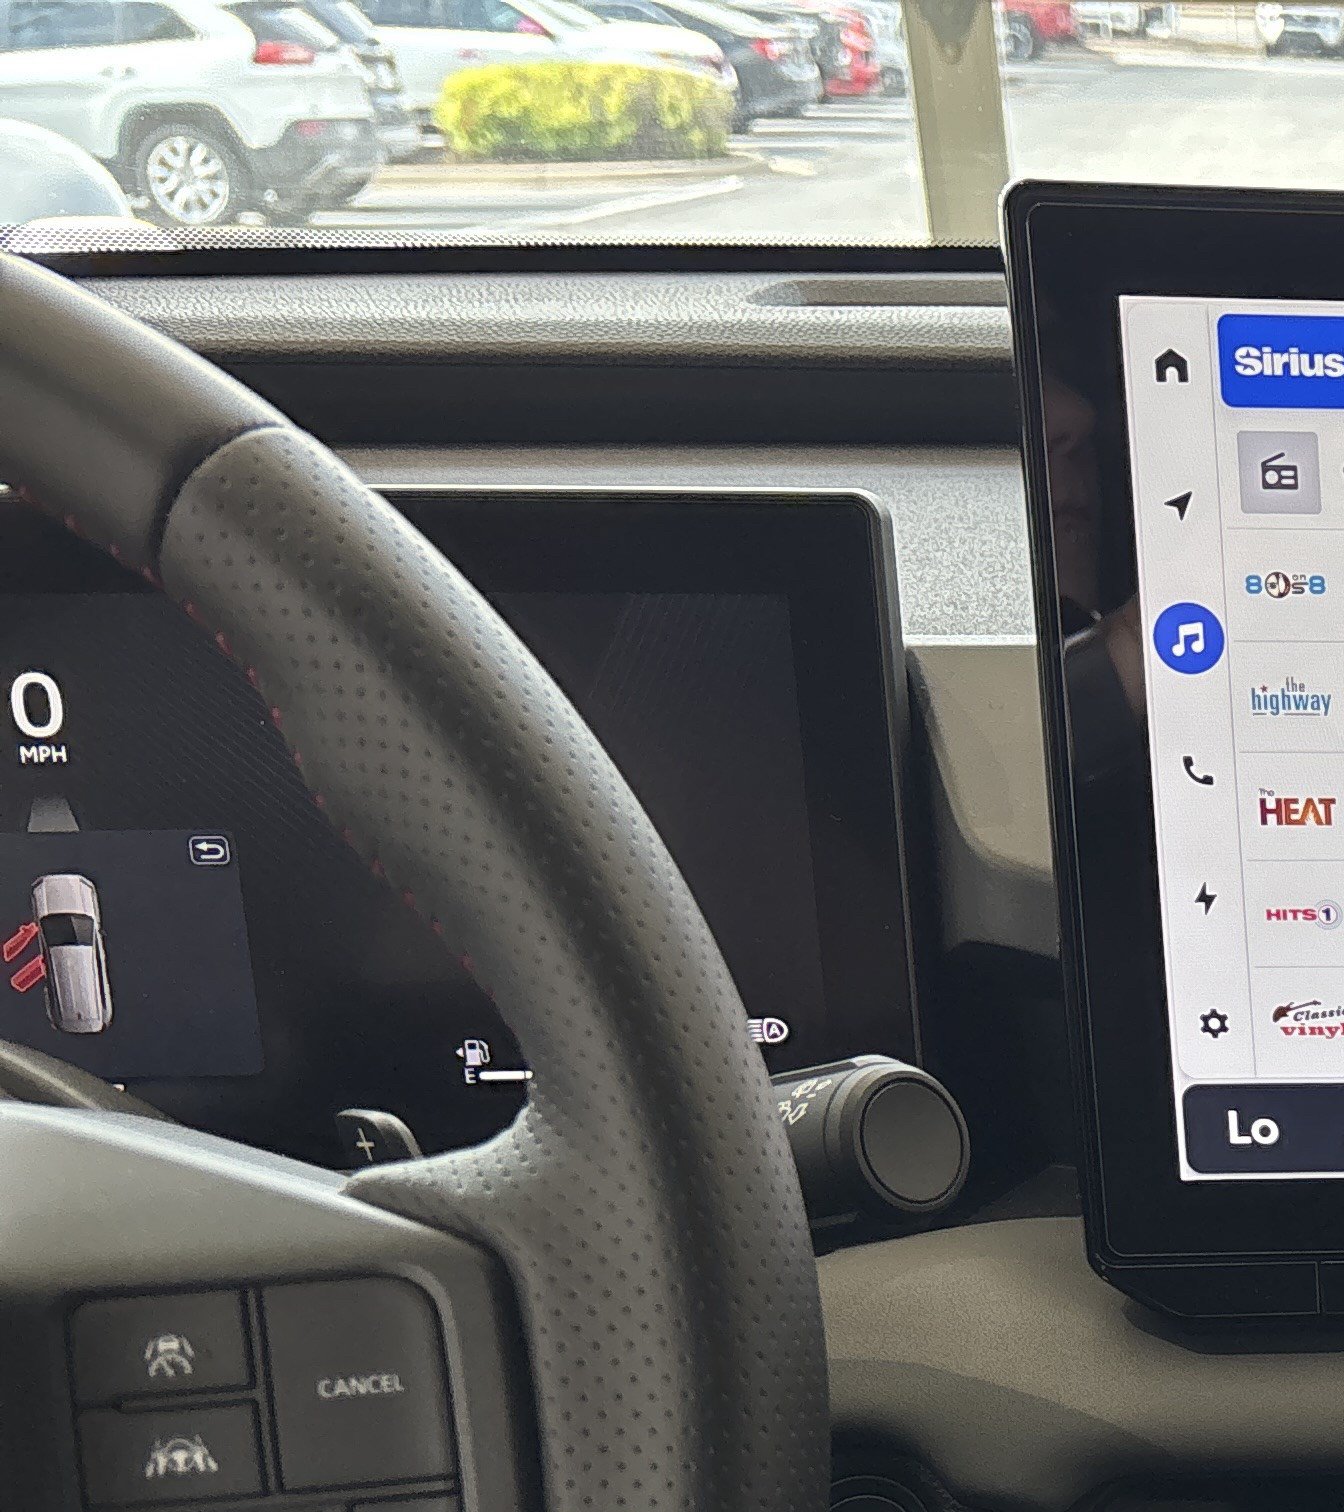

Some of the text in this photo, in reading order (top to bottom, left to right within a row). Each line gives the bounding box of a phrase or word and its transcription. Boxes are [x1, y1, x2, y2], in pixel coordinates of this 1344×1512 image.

[1286, 676, 1305, 692] the
[10, 671, 64, 738] 0
[1251, 687, 1332, 716] highway
[19, 745, 68, 764] MPH
[1259, 798, 1336, 826] HEAT
[1266, 908, 1317, 922] HITS
[1227, 1110, 1279, 1145] Lo
[317, 1374, 404, 1399] CANCEL
